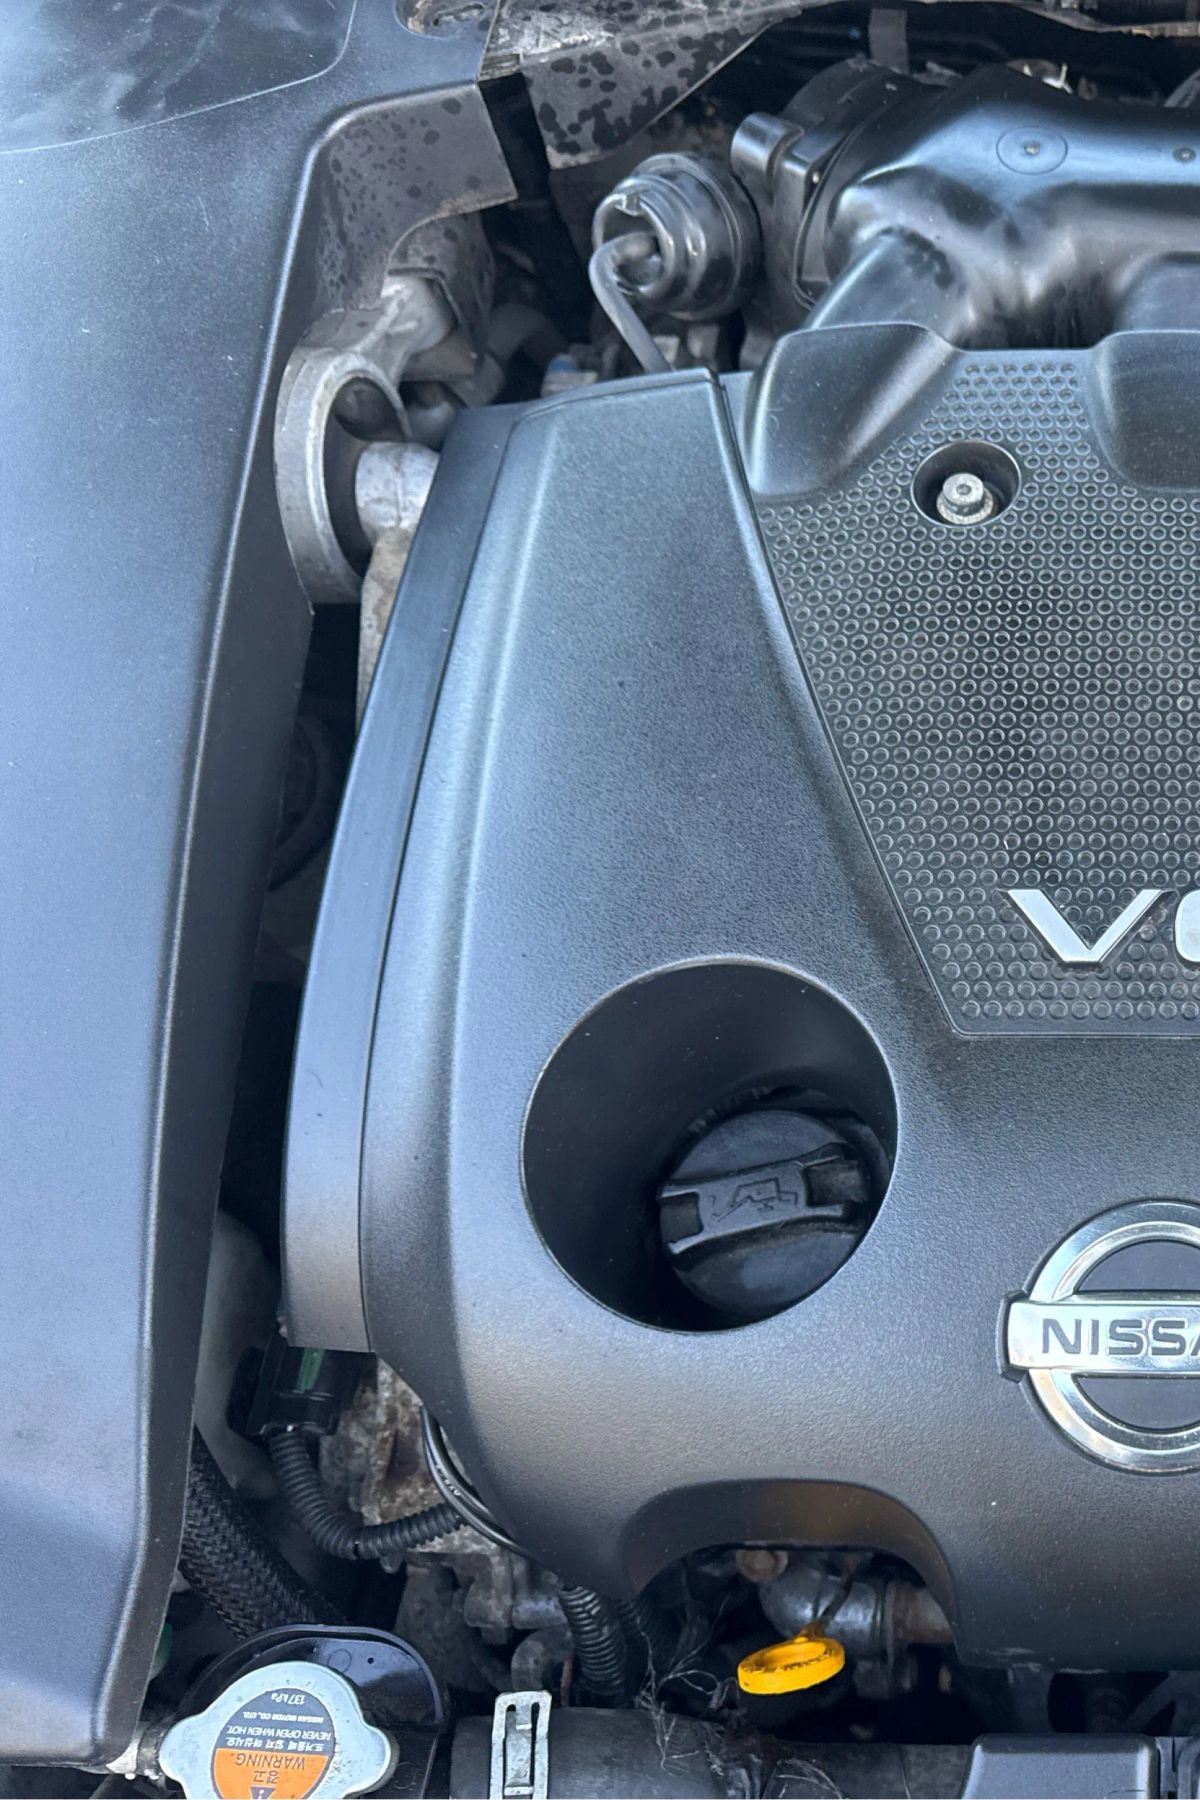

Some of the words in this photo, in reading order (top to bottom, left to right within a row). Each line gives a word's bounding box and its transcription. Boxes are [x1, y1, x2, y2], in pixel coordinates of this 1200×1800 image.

[271, 1692, 288, 1703] kPa
[287, 1692, 305, 1705] 137
[271, 1714, 297, 1722] MOTOR
[247, 1726, 275, 1737] WHEN
[276, 1728, 301, 1739] OPEN
[302, 1730, 332, 1740] NEVER
[253, 1770, 280, 1785] 경고
